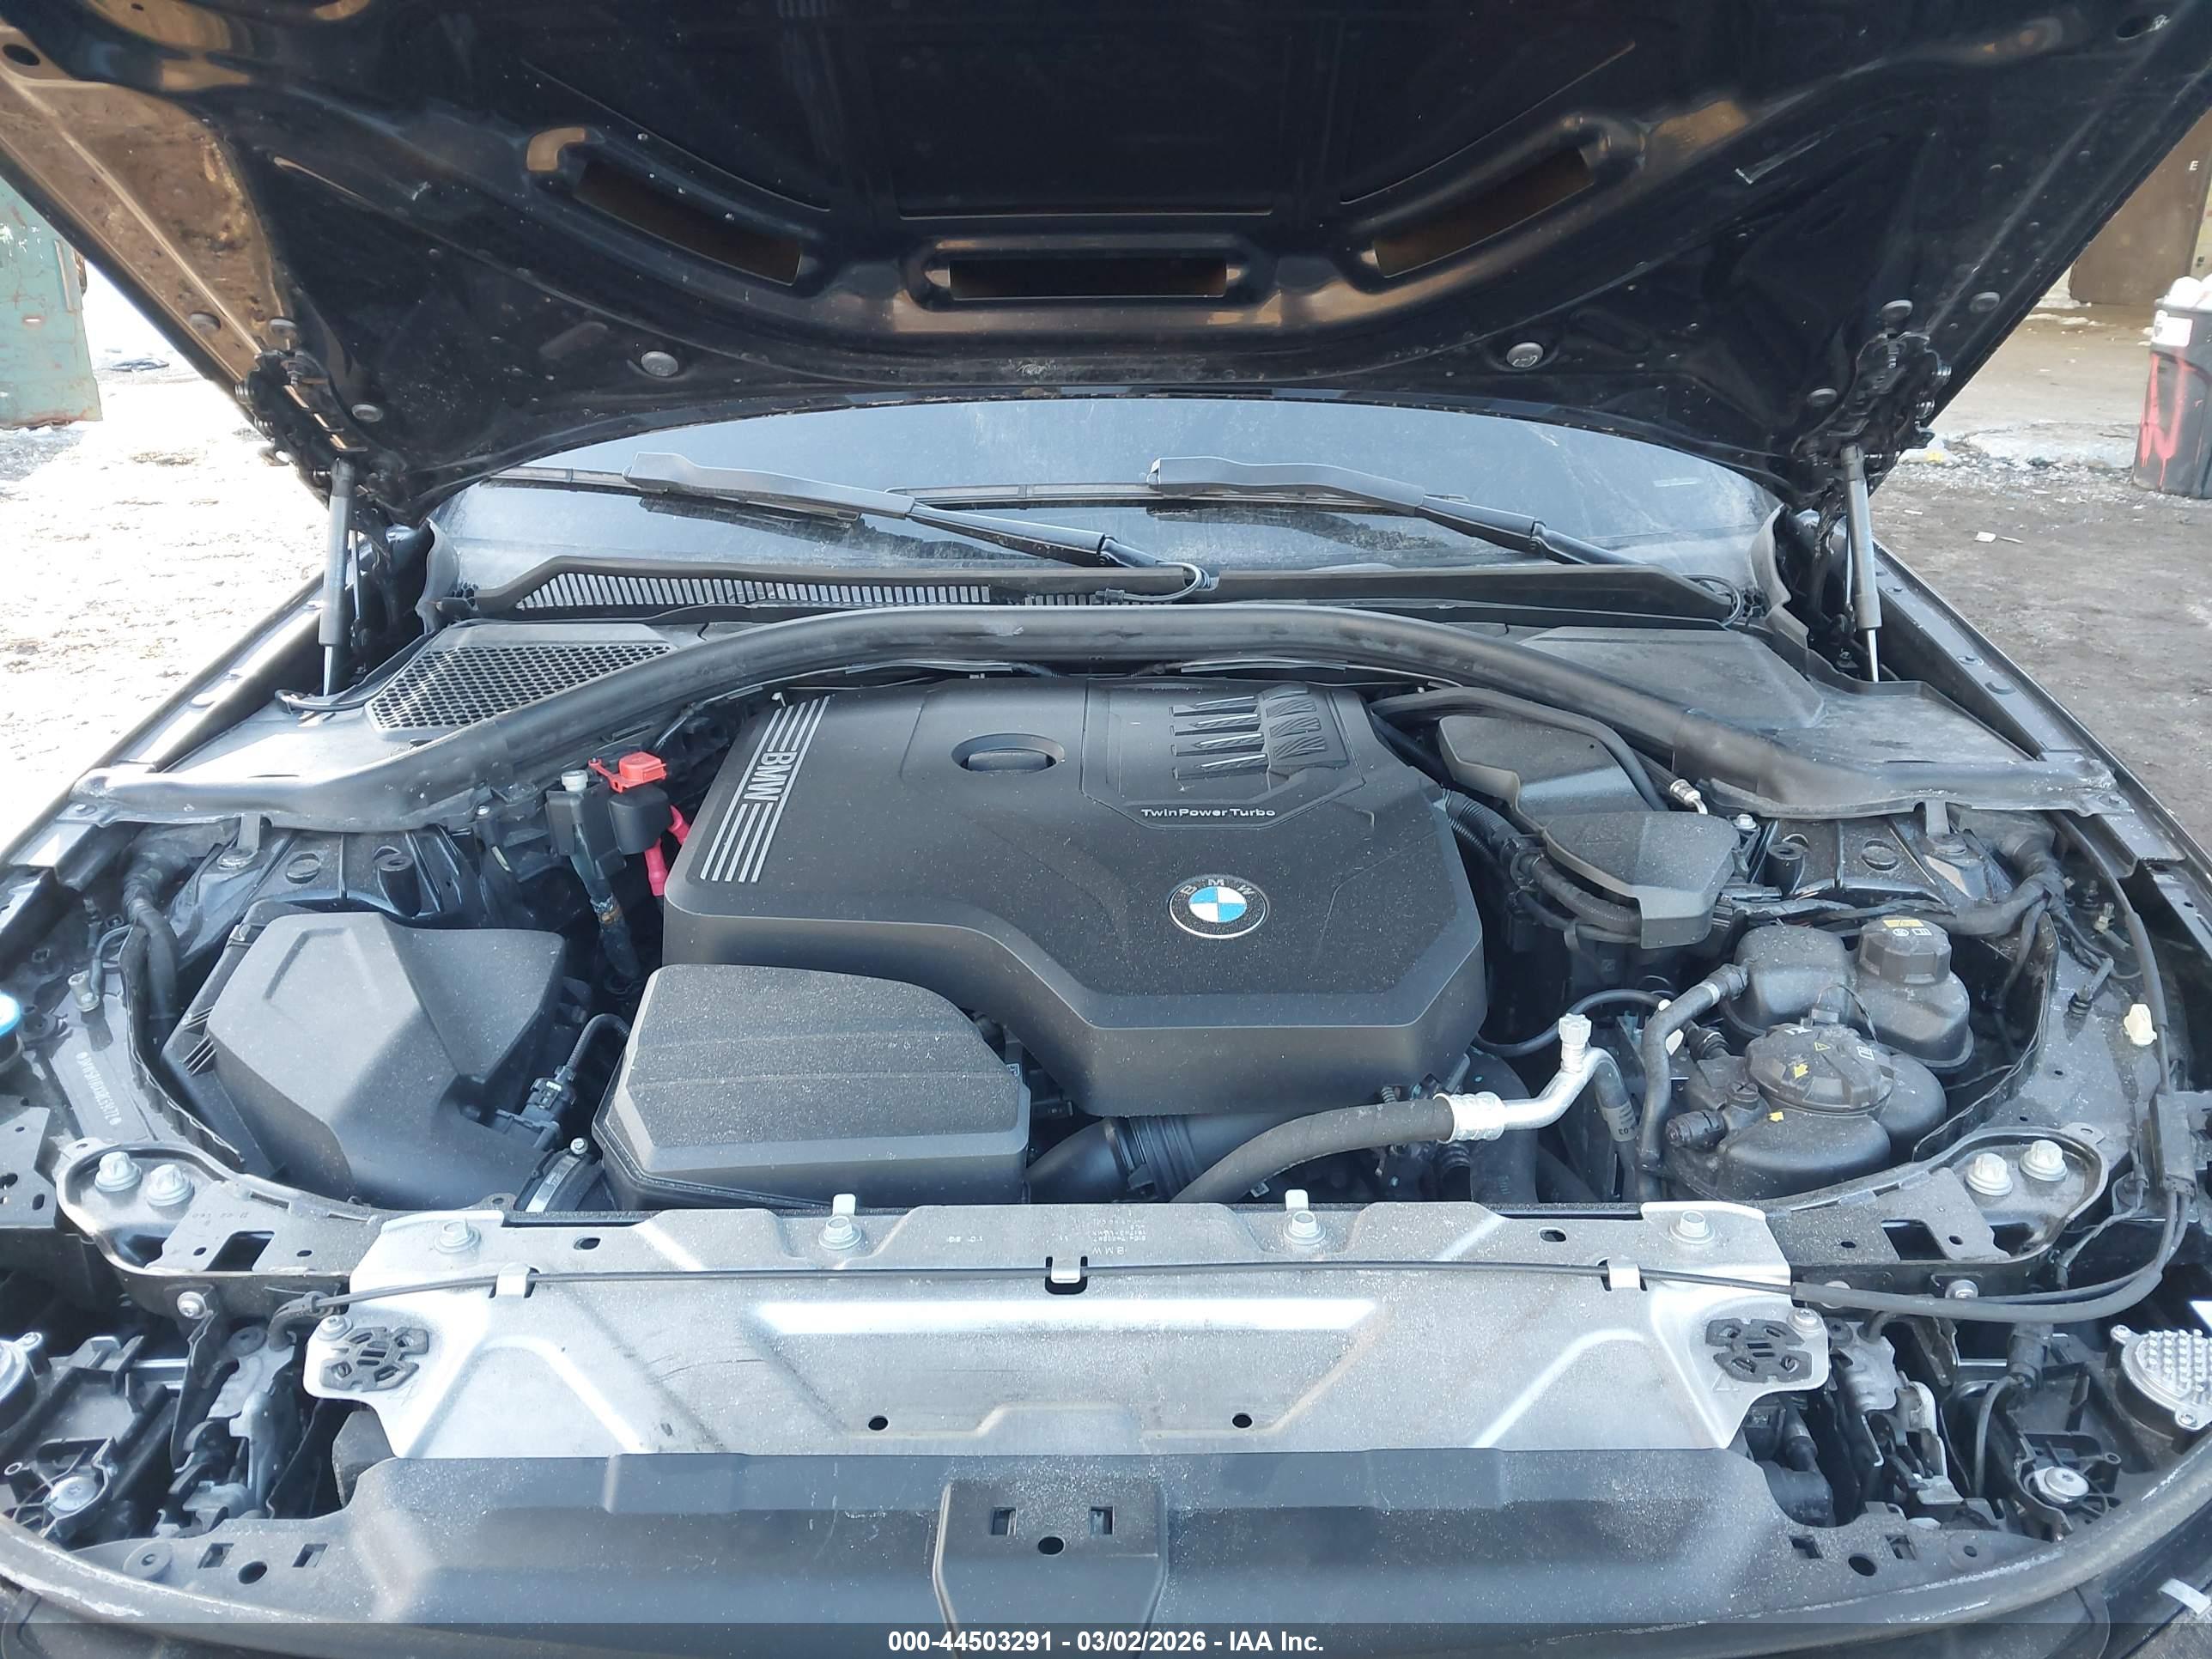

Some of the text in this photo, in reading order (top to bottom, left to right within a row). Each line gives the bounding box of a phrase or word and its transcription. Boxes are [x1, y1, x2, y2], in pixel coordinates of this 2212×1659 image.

[2189, 160, 2199, 171] E
[743, 751, 798, 801] BMW
[1229, 808, 1276, 817] Turbo
[1179, 878, 1256, 896] BMW
